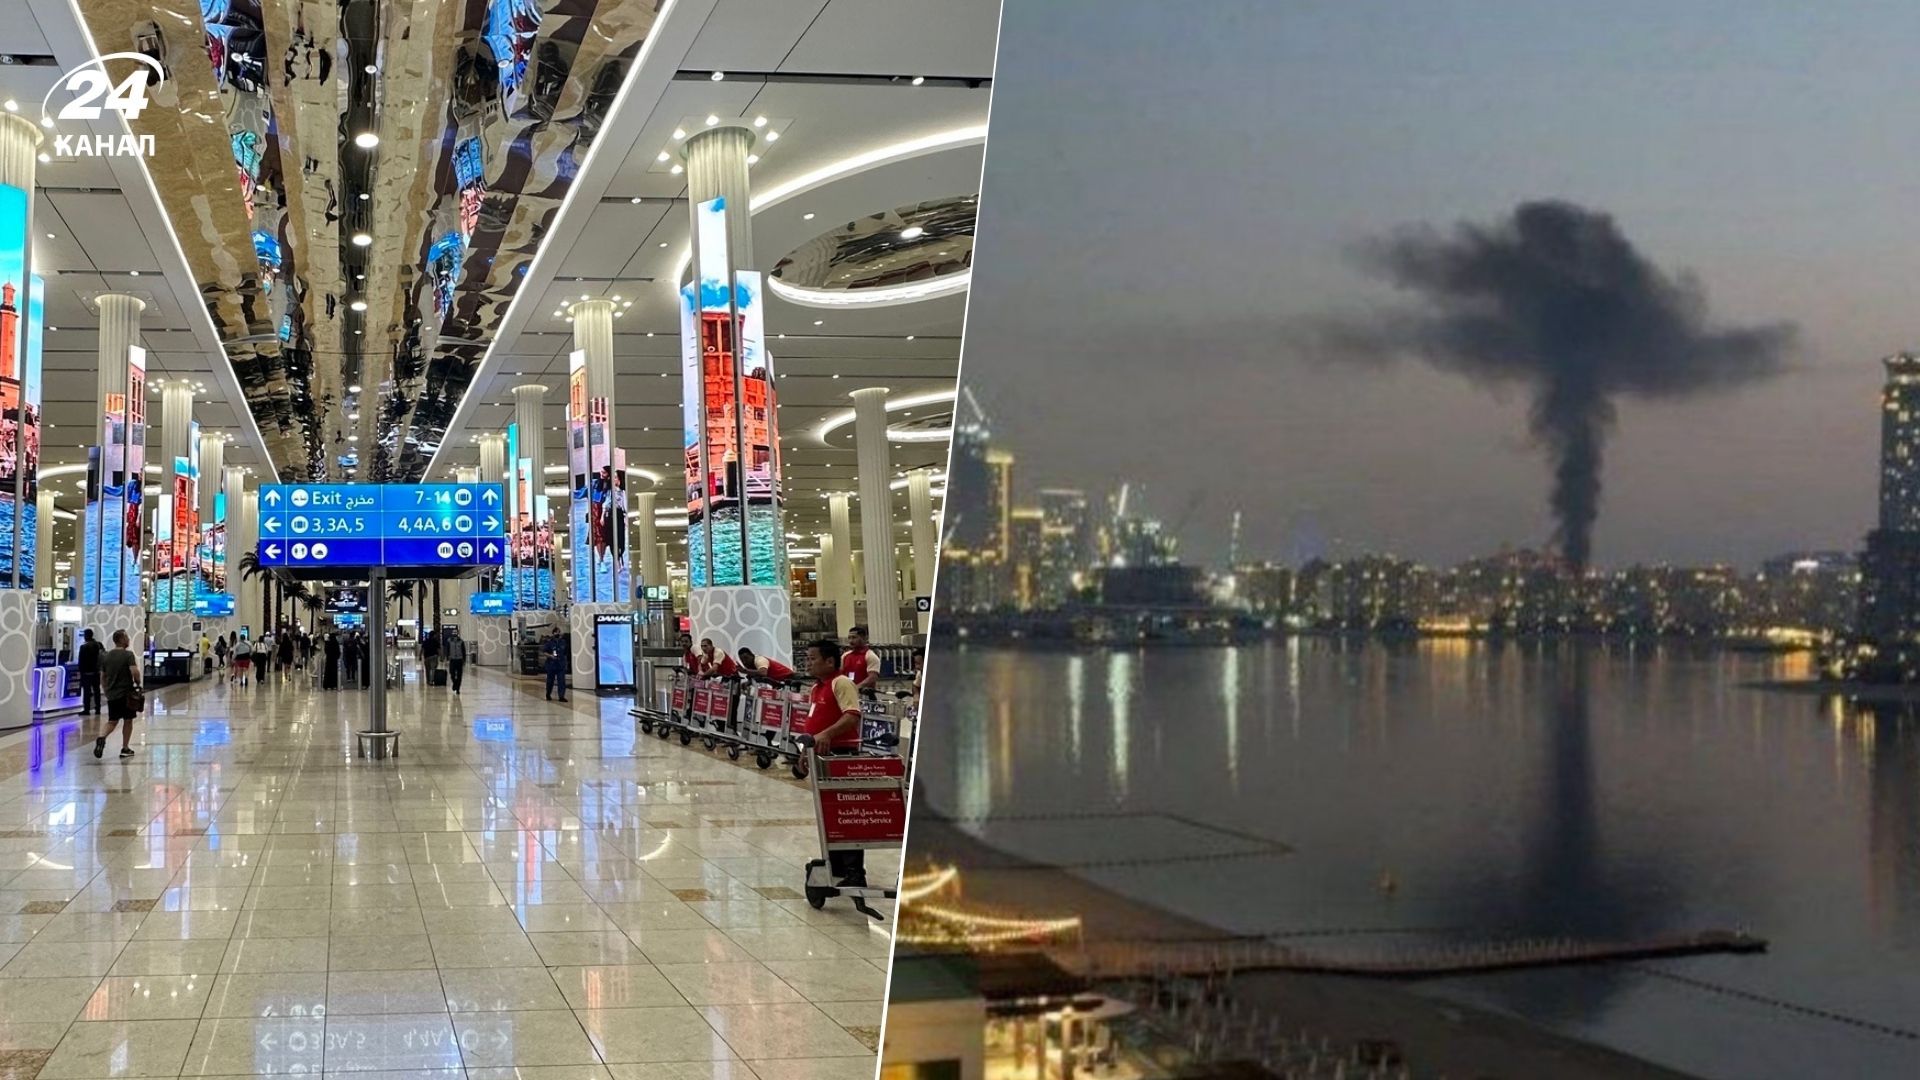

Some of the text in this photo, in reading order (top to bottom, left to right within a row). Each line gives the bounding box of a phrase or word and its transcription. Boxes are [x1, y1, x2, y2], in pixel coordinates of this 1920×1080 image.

[312, 490, 342, 505] Exit
[345, 494, 375, 510] مخرج
[837, 792, 871, 801] Emirates
[838, 817, 892, 826] Concierge Service
